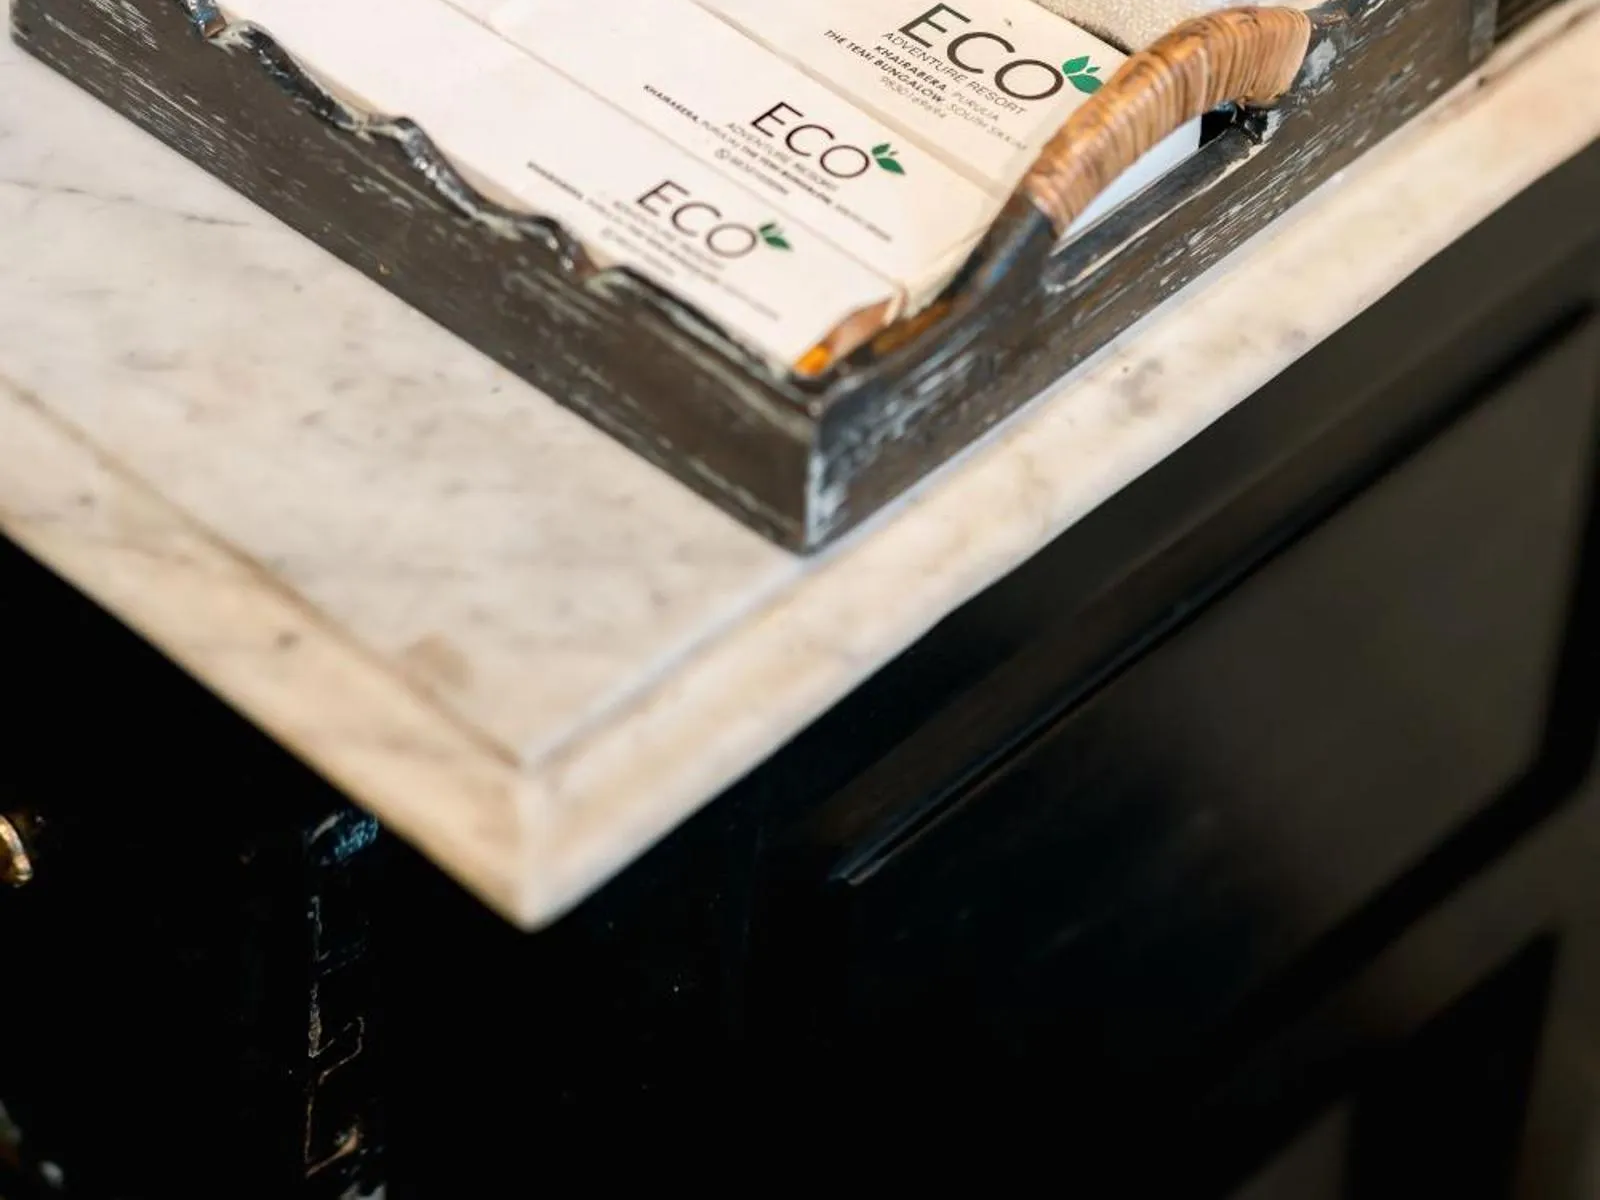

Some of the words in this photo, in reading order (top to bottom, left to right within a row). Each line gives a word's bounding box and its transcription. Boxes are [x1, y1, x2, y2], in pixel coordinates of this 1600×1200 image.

[824, 30, 848, 44] THE
[881, 32, 968, 83] ADVENTURE
[967, 80, 1028, 115] RESORT
[897, 2, 1064, 100] ECO
[750, 101, 870, 178] ECO
[636, 180, 758, 259] ECO
